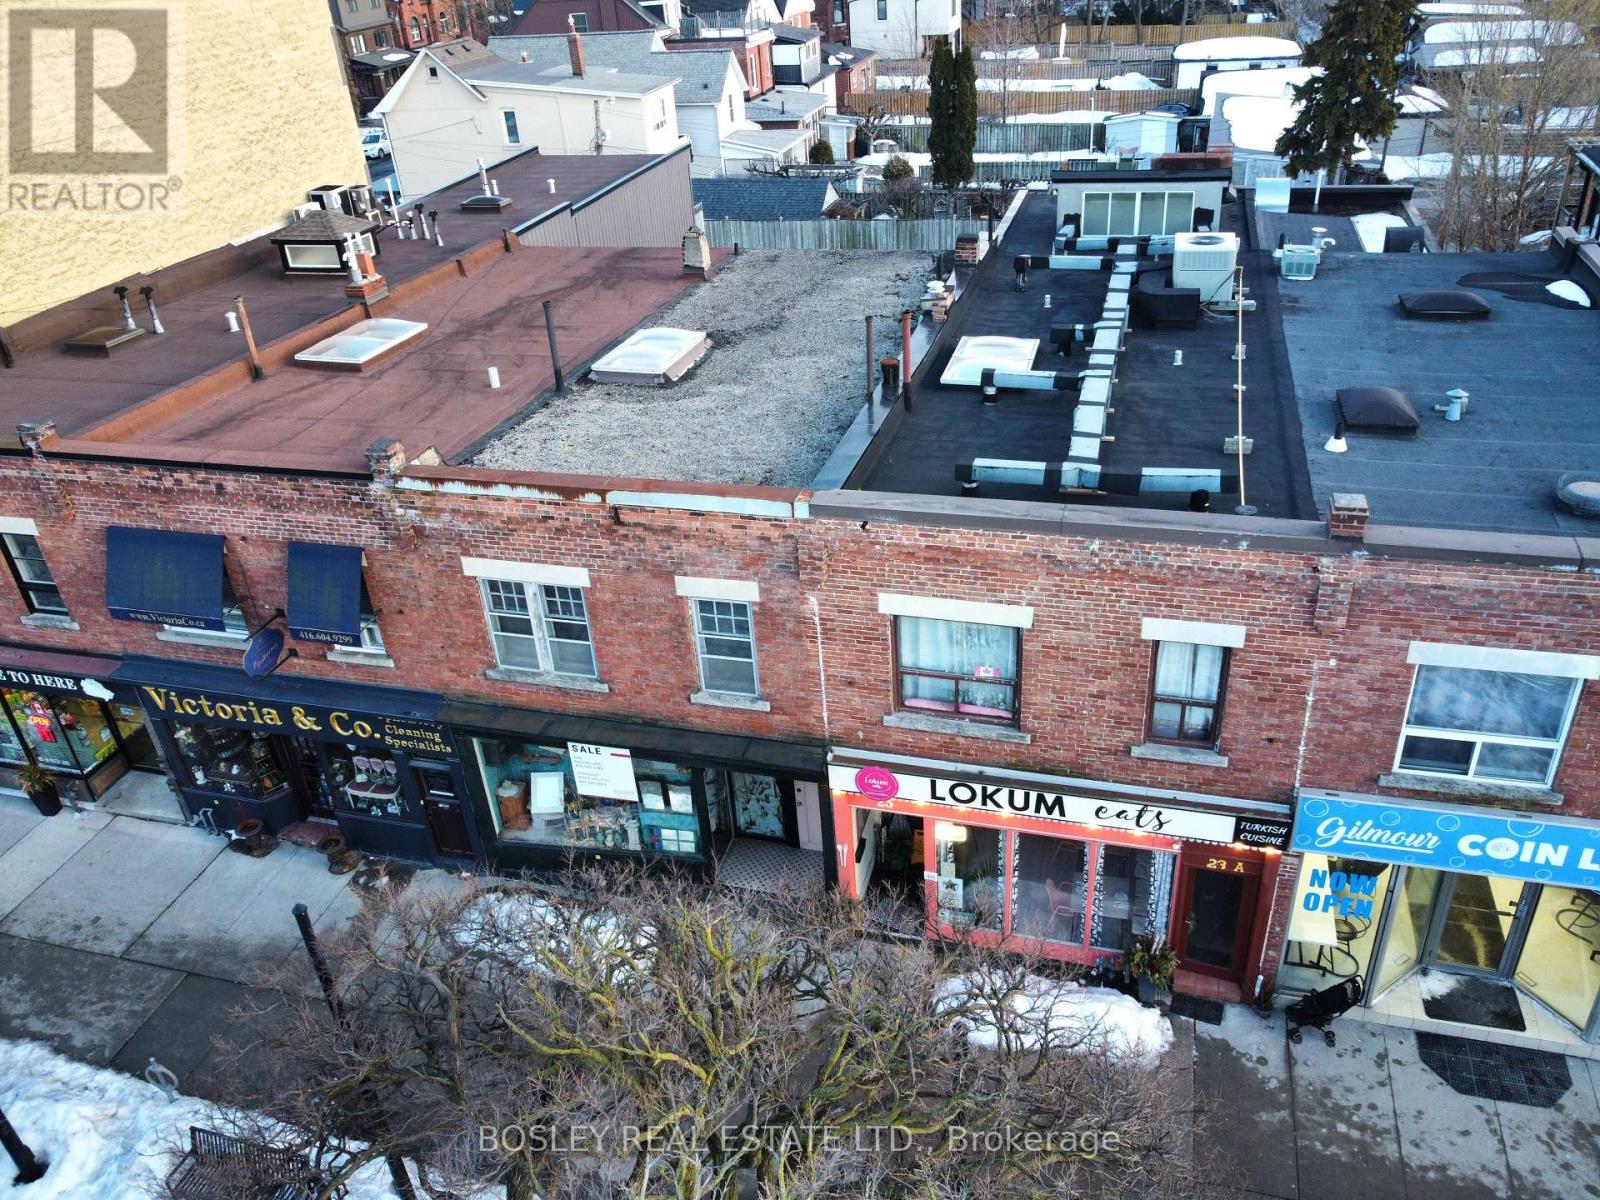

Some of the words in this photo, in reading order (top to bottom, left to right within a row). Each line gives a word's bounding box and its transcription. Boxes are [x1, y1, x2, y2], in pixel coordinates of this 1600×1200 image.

[129, 611, 205, 627] www.VictoriaCo.ca
[6, 670, 29, 684] TO
[31, 673, 77, 690] HERE
[142, 686, 283, 726] Victoria
[291, 706, 322, 731] &
[330, 711, 381, 739] Co.
[384, 724, 442, 742] Cleaning
[384, 735, 452, 753] Specialists
[571, 744, 602, 755] SALE
[930, 779, 1066, 818] LOKUM
[1094, 804, 1172, 832] eats
[1240, 821, 1288, 835] TURKISH
[1240, 832, 1285, 846] CUISINE
[1314, 816, 1441, 850] Gilmour
[1457, 834, 1569, 867] COIN
[1206, 858, 1227, 870] 23
[1233, 862, 1245, 873] A
[1309, 868, 1378, 897] NOW
[1303, 892, 1373, 919] OPEN
